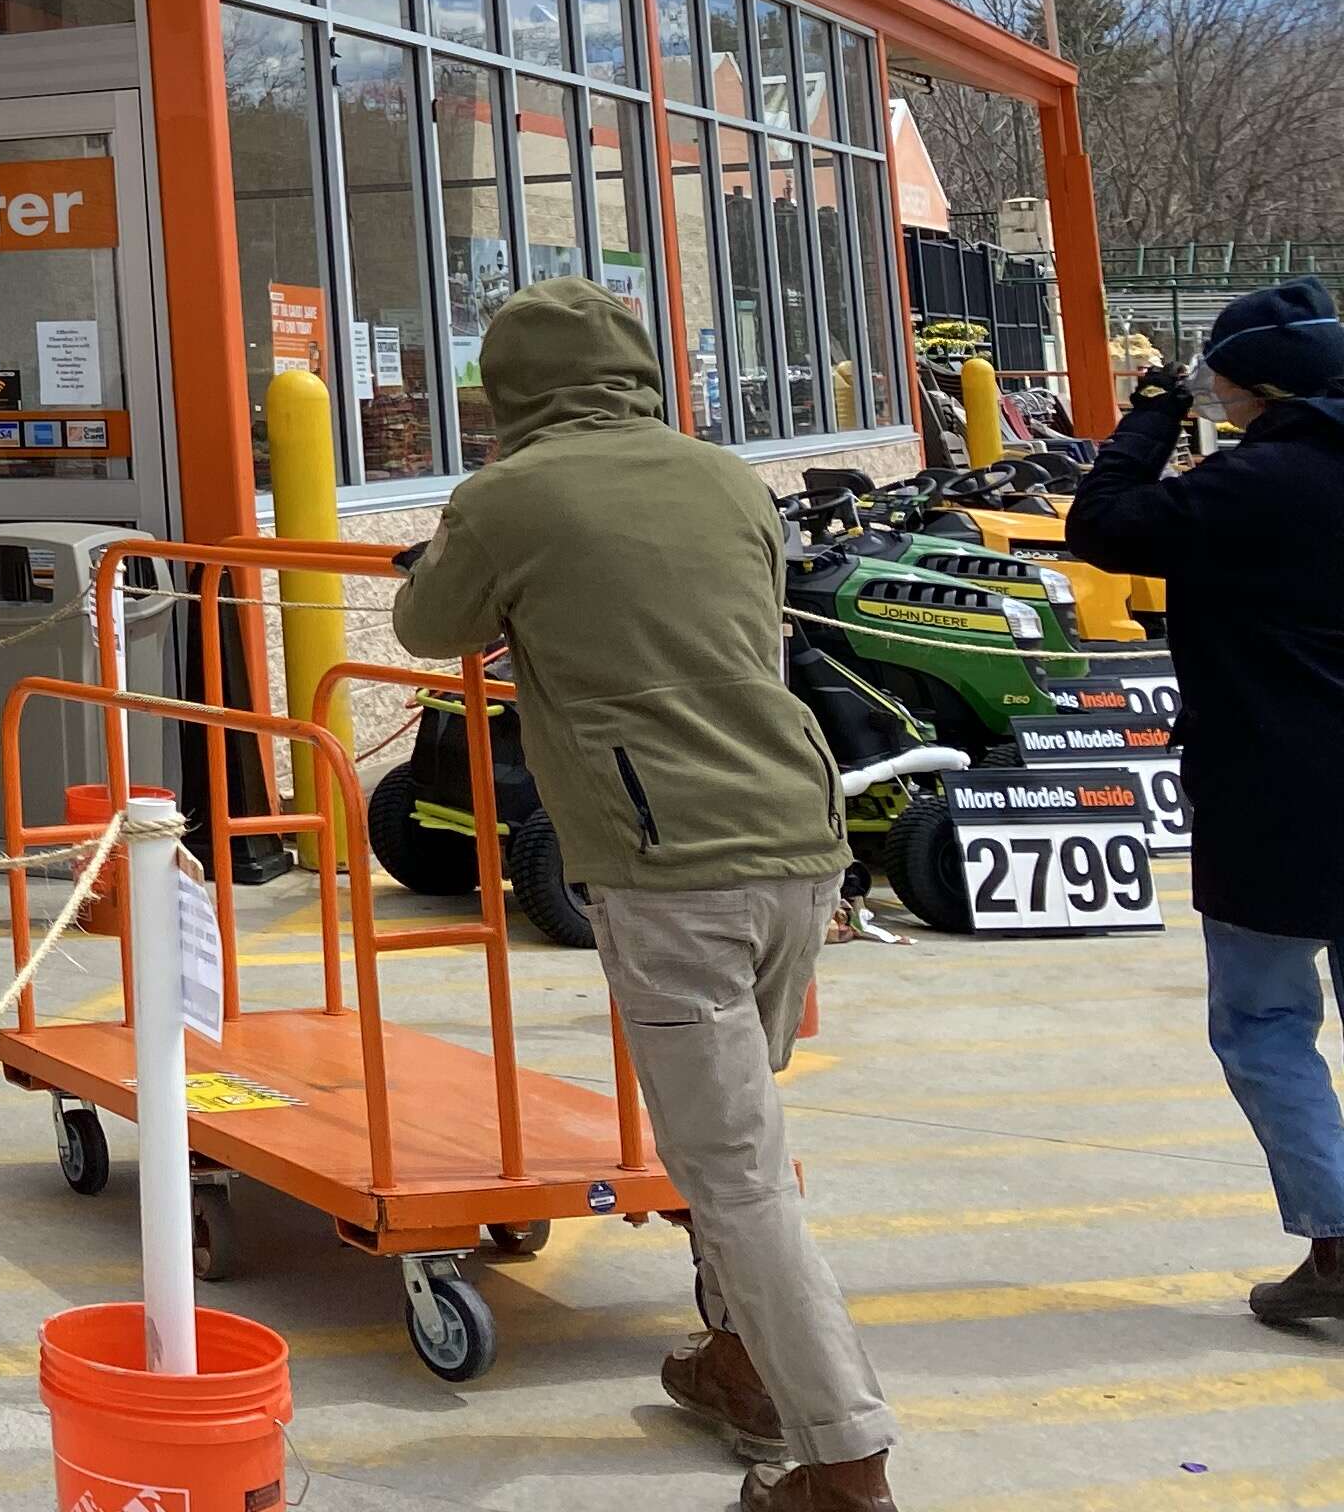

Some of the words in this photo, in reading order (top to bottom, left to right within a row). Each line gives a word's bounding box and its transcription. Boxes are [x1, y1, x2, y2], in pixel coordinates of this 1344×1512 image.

[879, 604, 920, 621] JOHN
[923, 612, 969, 628] DEERE
[1080, 691, 1127, 708] Inside
[1022, 731, 1066, 750] More
[1066, 729, 1125, 748] Models
[1125, 728, 1171, 747] Inside
[955, 786, 1006, 809] More
[1009, 784, 1076, 808] Models
[1079, 784, 1135, 807] Inside
[966, 835, 1153, 914] 2799
